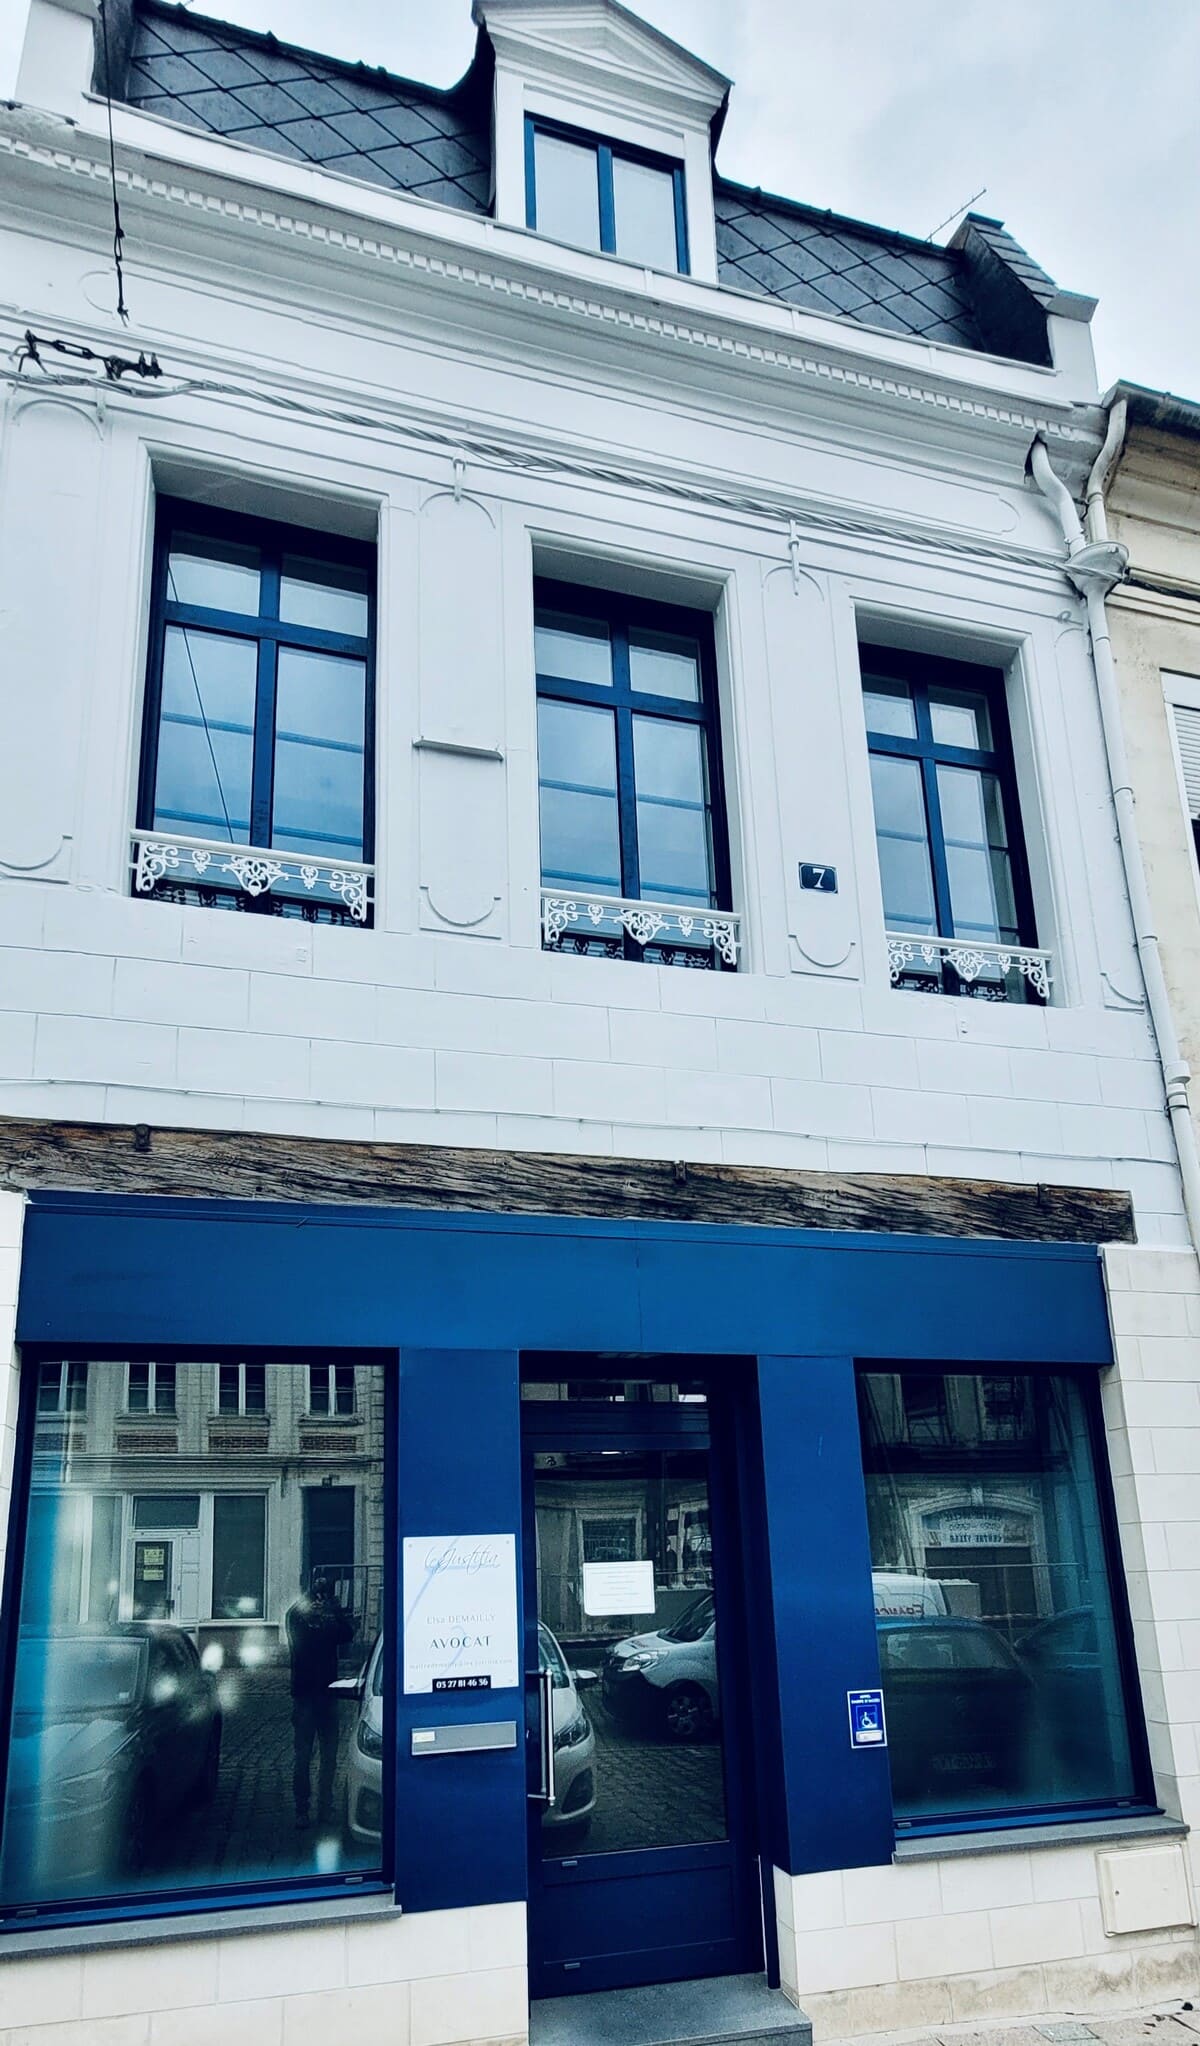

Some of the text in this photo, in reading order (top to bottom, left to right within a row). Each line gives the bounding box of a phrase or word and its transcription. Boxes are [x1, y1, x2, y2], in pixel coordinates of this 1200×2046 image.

[812, 867, 826, 889] 7
[430, 1635, 492, 1649] AVOCAT
[447, 1679, 457, 1688] 27
